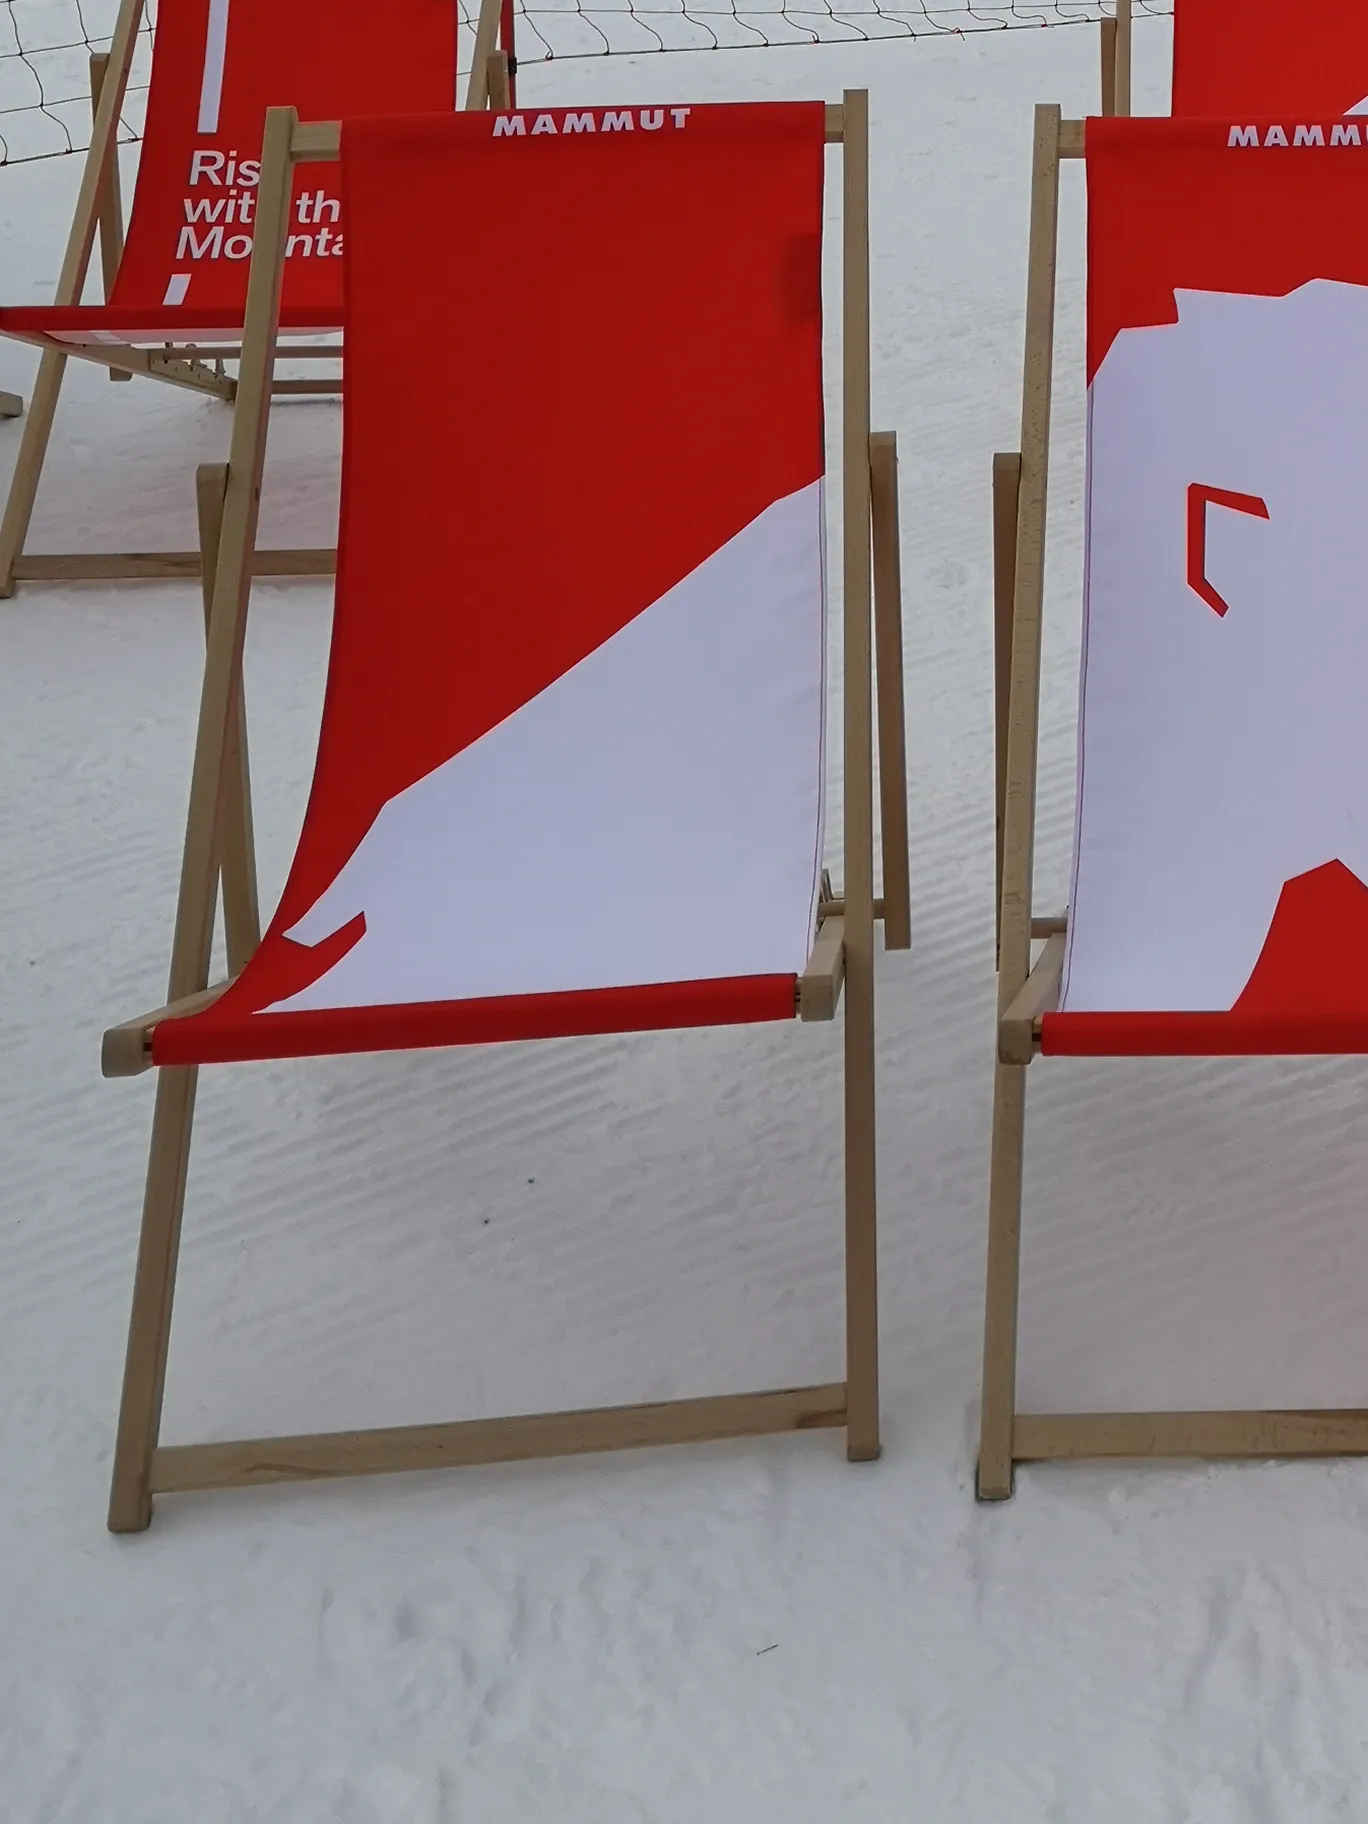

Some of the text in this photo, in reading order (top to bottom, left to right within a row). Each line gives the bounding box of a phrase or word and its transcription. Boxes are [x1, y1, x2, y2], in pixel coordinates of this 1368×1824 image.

[492, 108, 691, 136] MAMMUT
[189, 150, 261, 187] Ris
[183, 189, 340, 224] wit th
[175, 226, 343, 260] Mont
